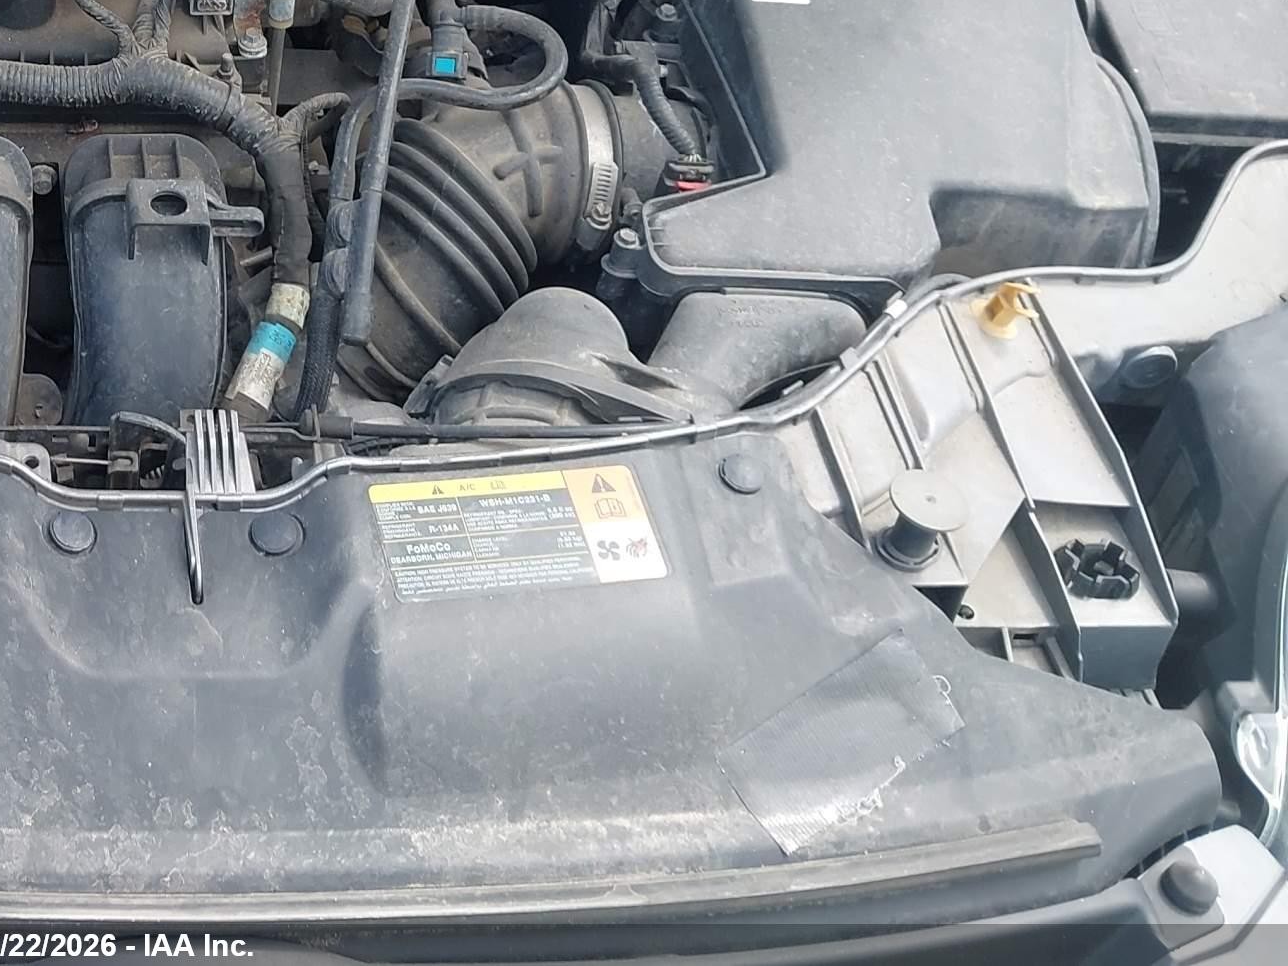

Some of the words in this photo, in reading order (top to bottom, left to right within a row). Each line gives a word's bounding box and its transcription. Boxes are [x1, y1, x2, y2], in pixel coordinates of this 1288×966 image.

[459, 483, 476, 492] A/C
[428, 523, 460, 533] R-134A
[406, 541, 451, 555] FoMoCo
[435, 550, 473, 561] MICHIGAN
